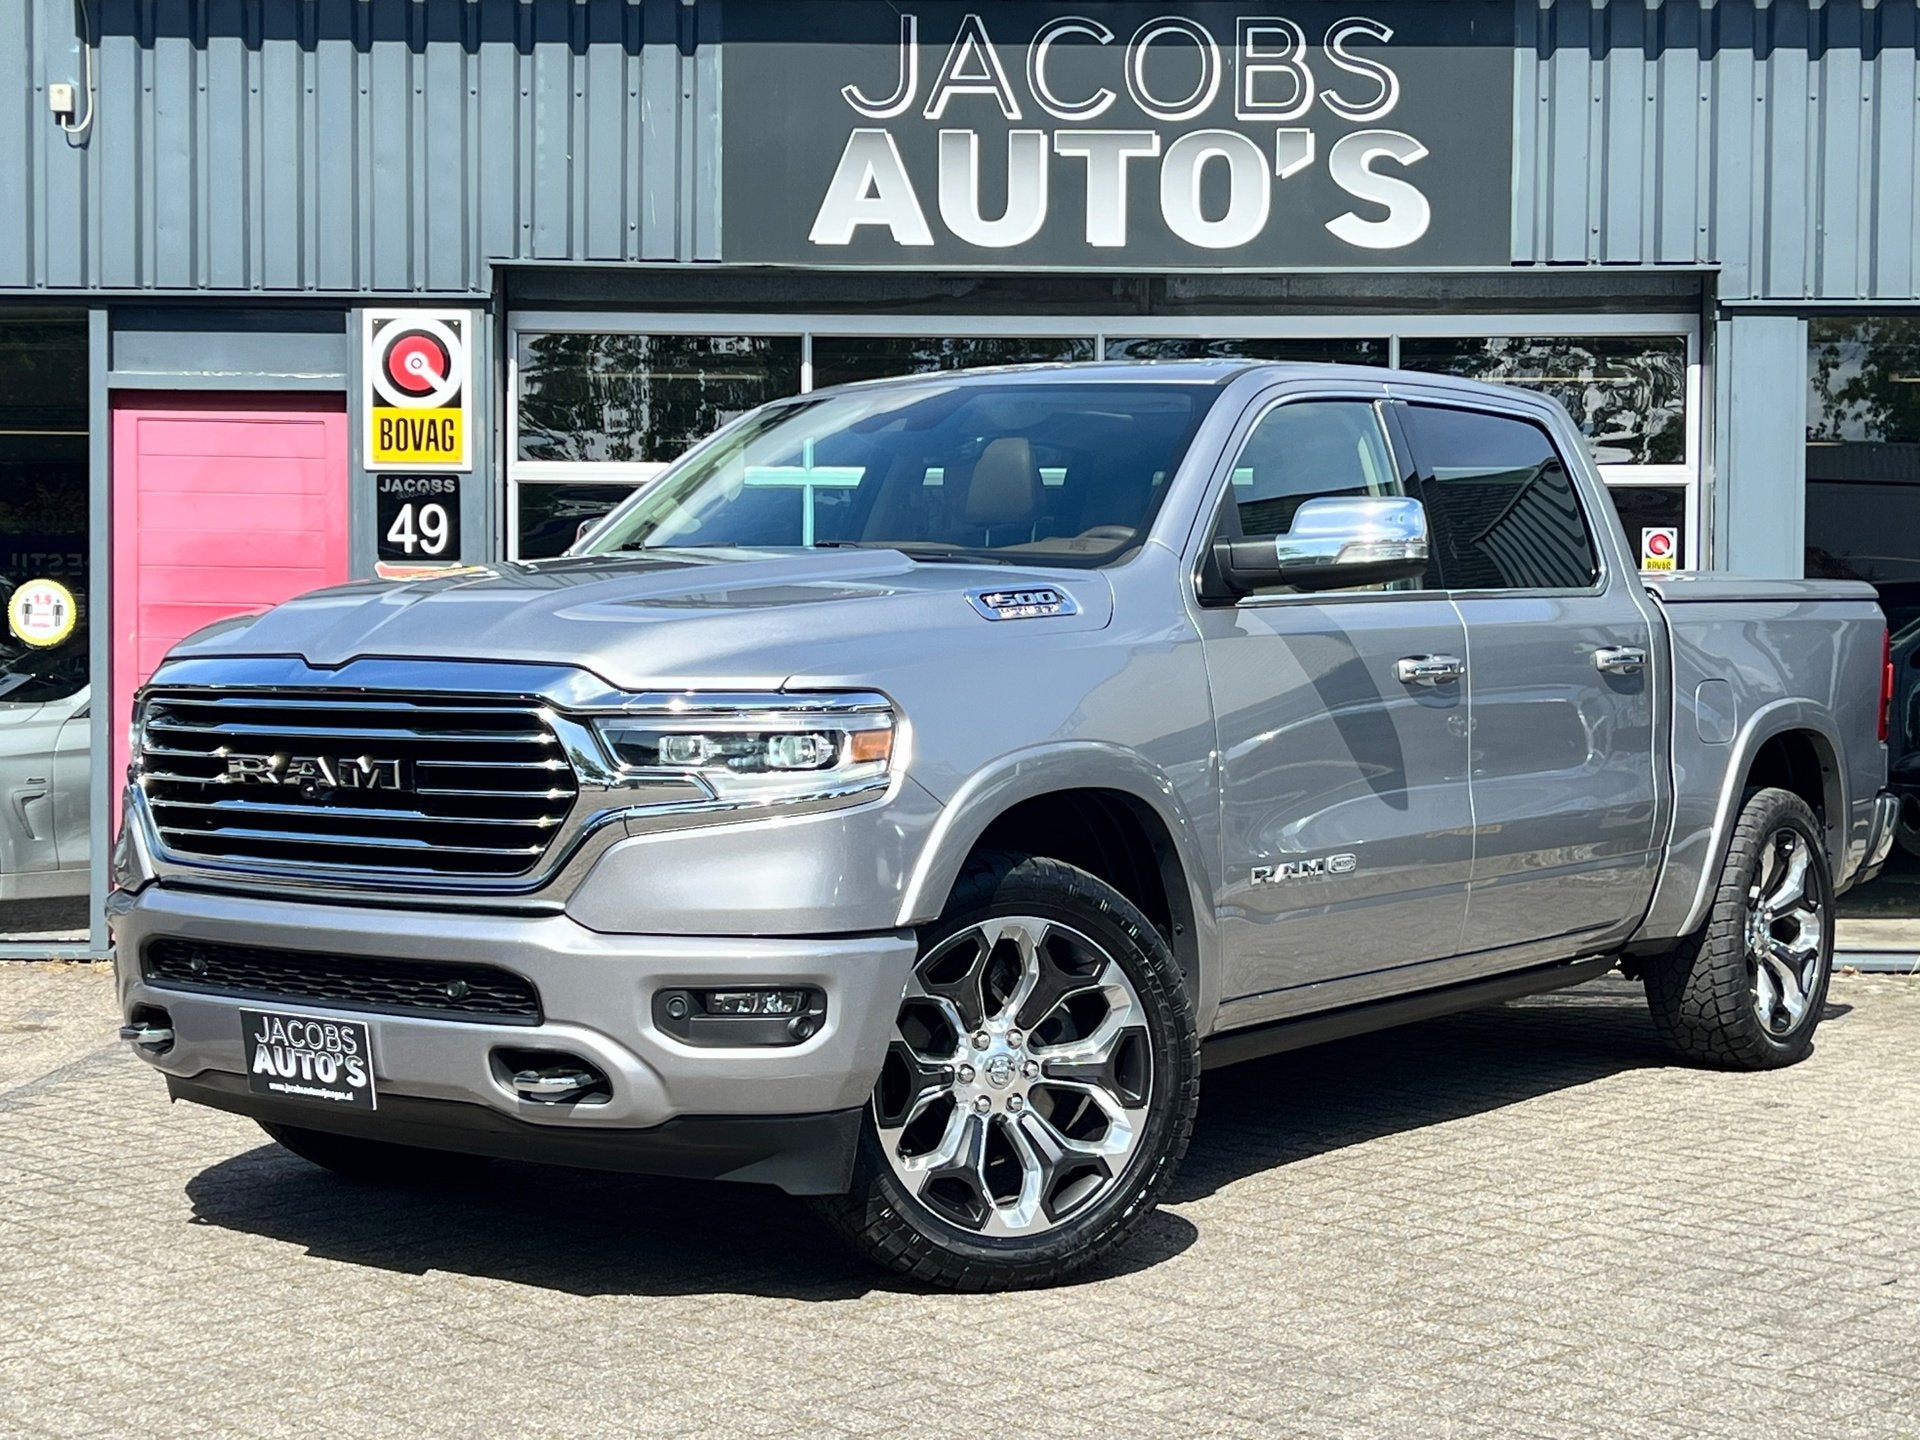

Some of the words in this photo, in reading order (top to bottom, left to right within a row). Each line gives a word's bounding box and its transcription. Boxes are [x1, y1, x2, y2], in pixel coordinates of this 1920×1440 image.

[840, 14, 1400, 122] JACOBS
[808, 128, 1431, 249] AUTO'S
[379, 417, 455, 452] BOVAG
[379, 478, 456, 494] JACOBS
[386, 502, 449, 555] 49
[226, 753, 401, 791] RAM
[1251, 858, 1324, 886] RAM
[254, 1016, 358, 1055] JACOBS
[253, 1043, 367, 1088] AUTO'S
